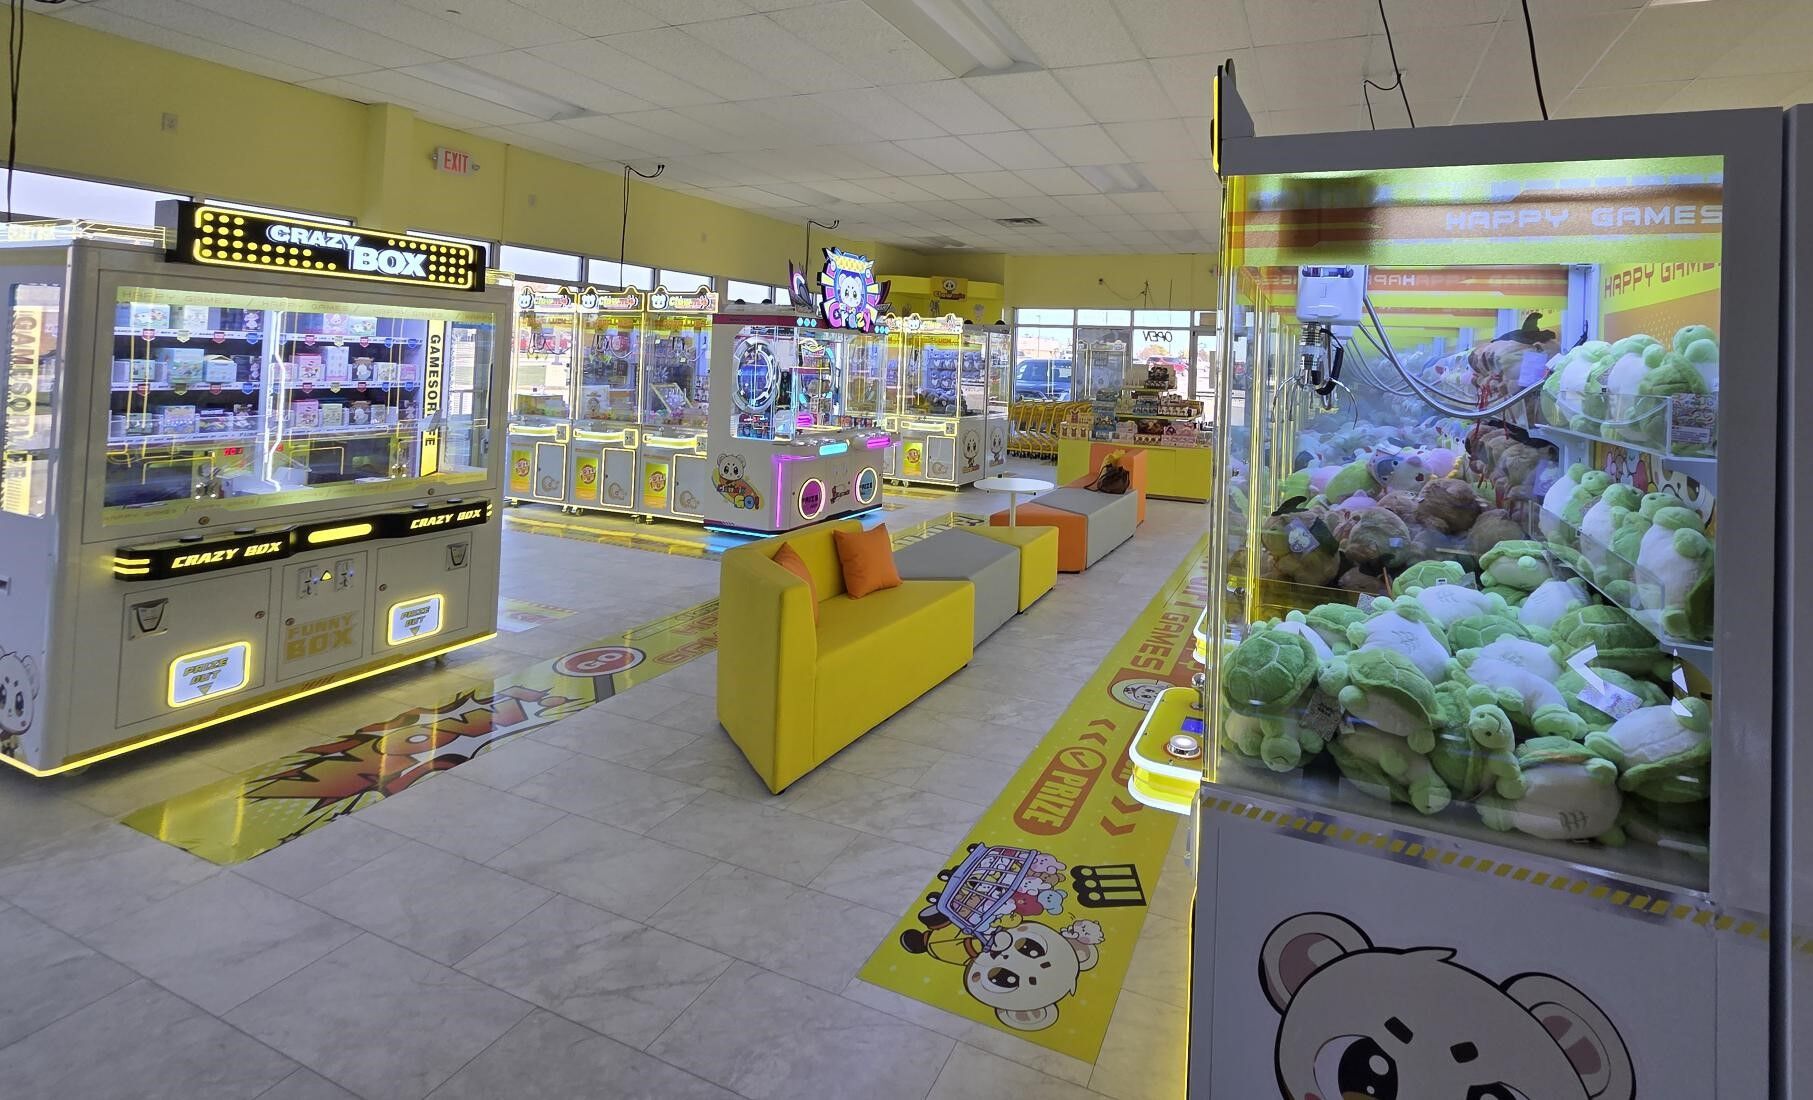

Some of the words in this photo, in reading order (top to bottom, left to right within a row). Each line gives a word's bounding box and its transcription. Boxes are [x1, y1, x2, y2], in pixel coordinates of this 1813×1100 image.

[444, 150, 469, 173] EXIT
[1446, 208, 1569, 230] HAPPY
[1591, 204, 1722, 228] GAMES
[266, 224, 360, 250] CRAZY
[349, 249, 427, 278] BOX
[1604, 263, 1655, 299] HAPPY
[425, 334, 441, 447] GAMESORFE
[410, 514, 454, 530] CRAZY
[457, 509, 481, 521] BOX
[171, 548, 239, 568] CRAZY
[243, 541, 283, 557] BOX
[400, 606, 430, 619] PRIZE
[286, 612, 357, 640] FUNNY
[286, 629, 356, 662] BOX
[1130, 612, 1190, 671] GAMES
[183, 657, 228, 676] PRIZE
[577, 652, 623, 670] GO
[190, 669, 221, 685] OUT
[1022, 770, 1088, 828] PRIZE
